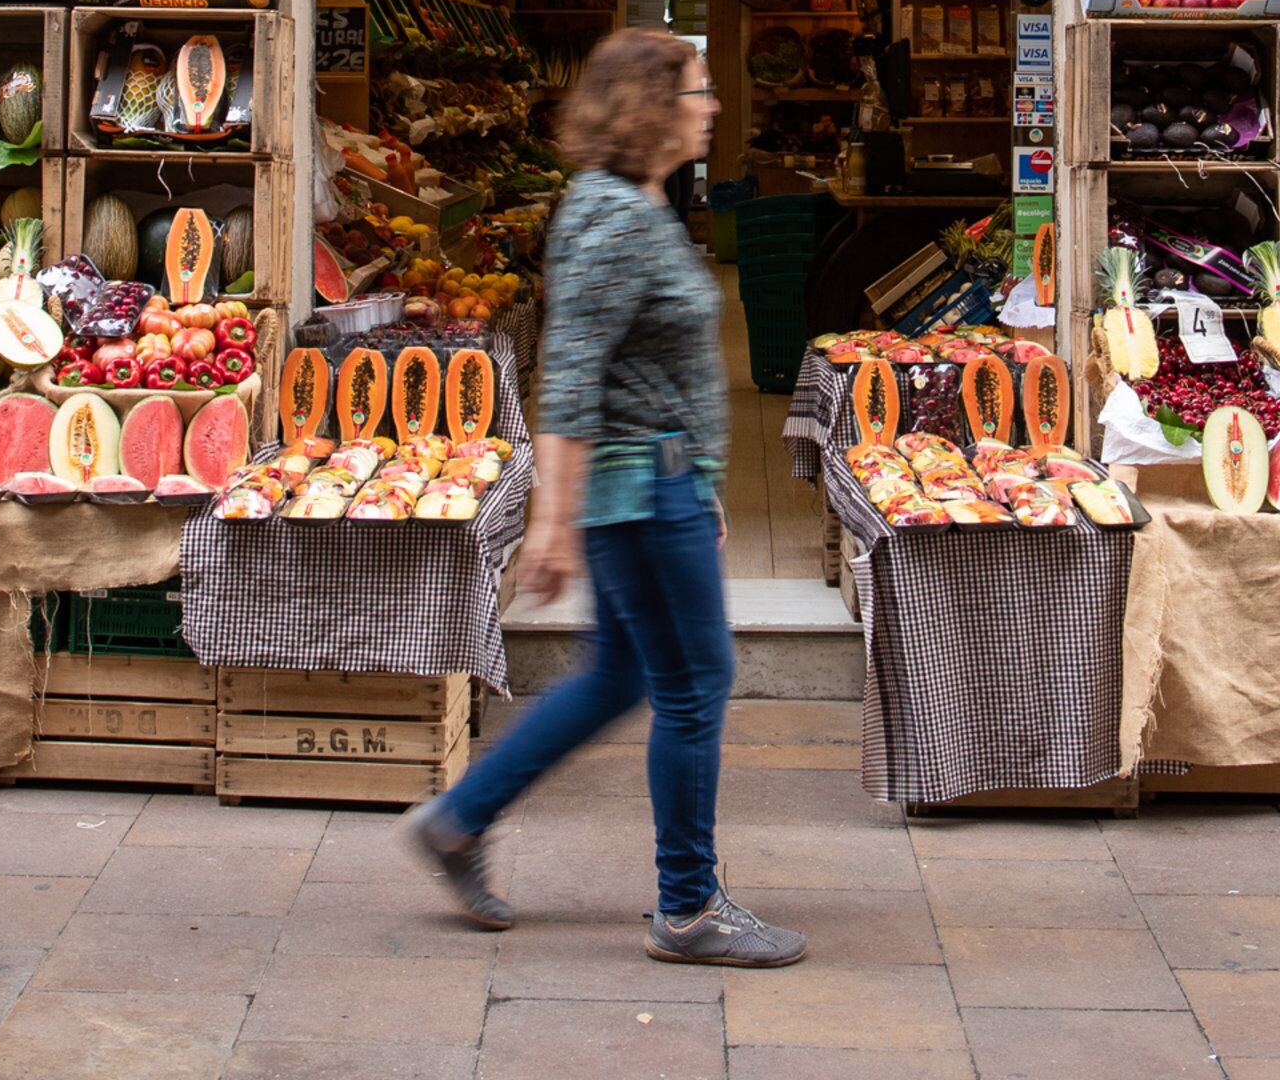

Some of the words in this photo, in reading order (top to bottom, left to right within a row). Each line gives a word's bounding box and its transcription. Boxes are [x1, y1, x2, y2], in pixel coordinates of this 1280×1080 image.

[1023, 22, 1049, 33] VISA
[1023, 48, 1049, 59] VISA
[1193, 308, 1207, 337] 4
[297, 727, 394, 753] B.G.M.
